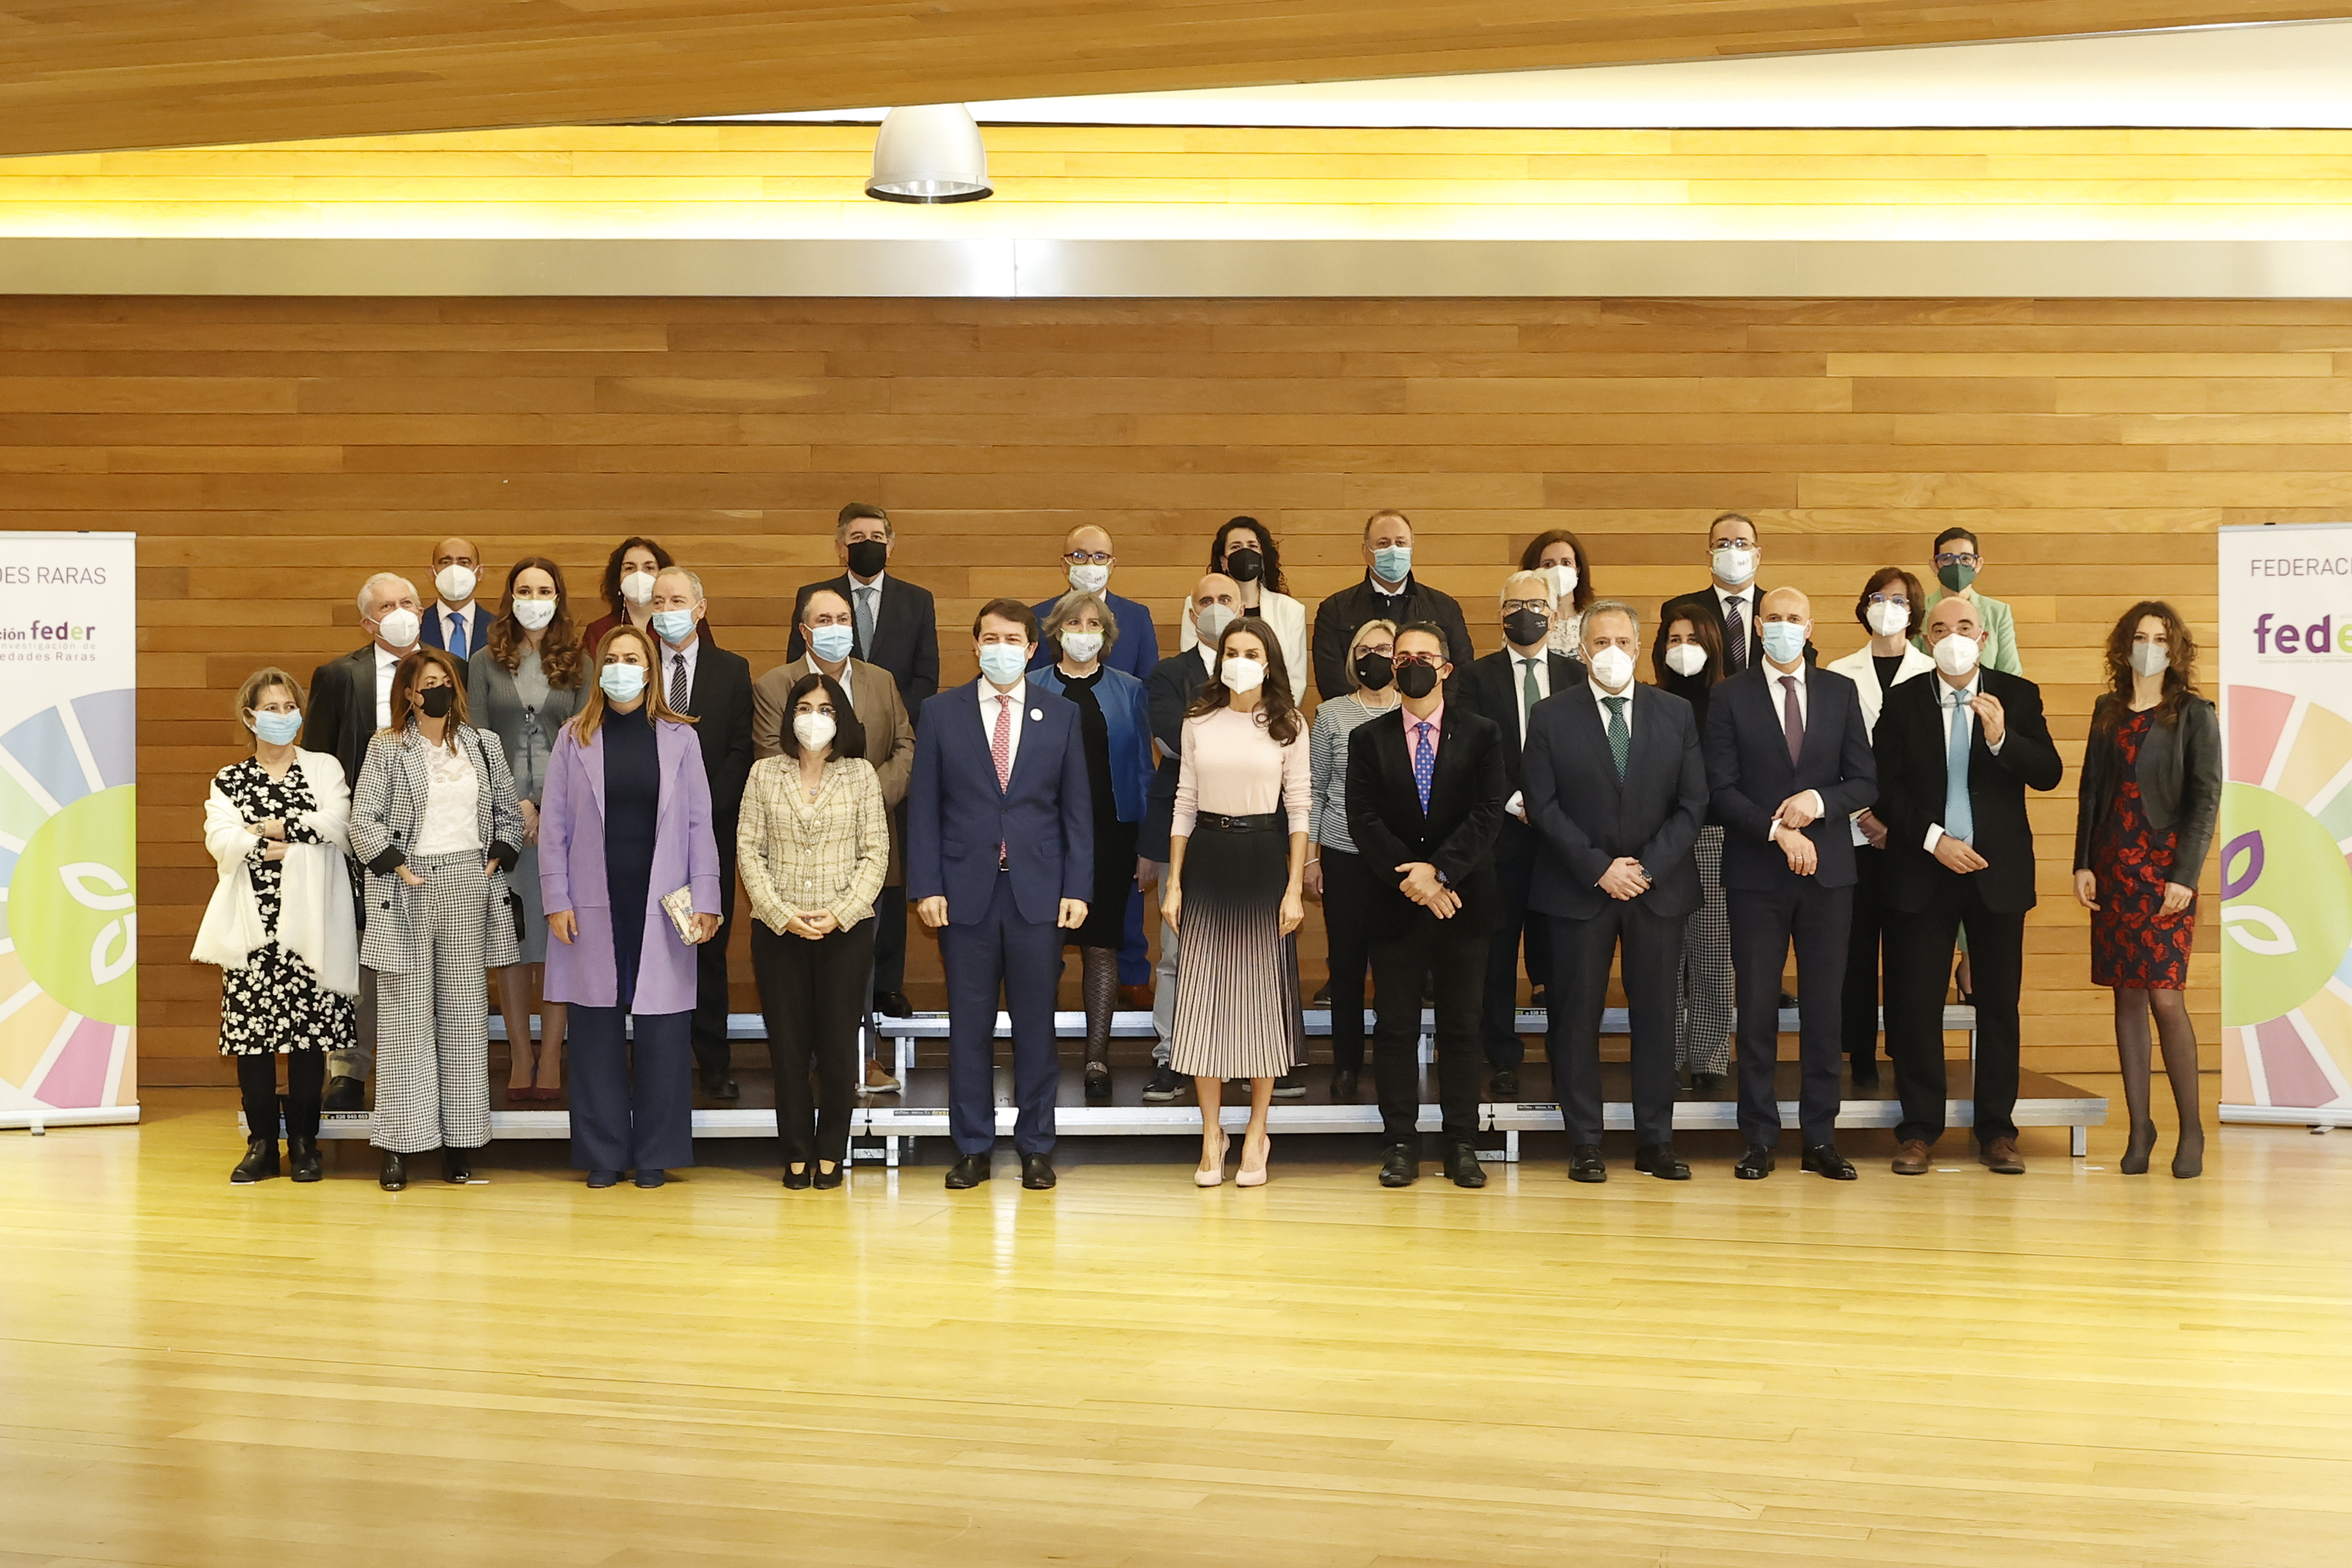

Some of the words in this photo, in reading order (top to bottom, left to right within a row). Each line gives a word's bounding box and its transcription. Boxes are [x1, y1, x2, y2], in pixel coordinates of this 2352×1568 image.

[0, 566, 30, 584] ES
[38, 567, 106, 585] RARAS
[0, 628, 26, 640] ión
[30, 620, 96, 640] feder
[0, 652, 50, 661] edades
[56, 652, 96, 661] Raras
